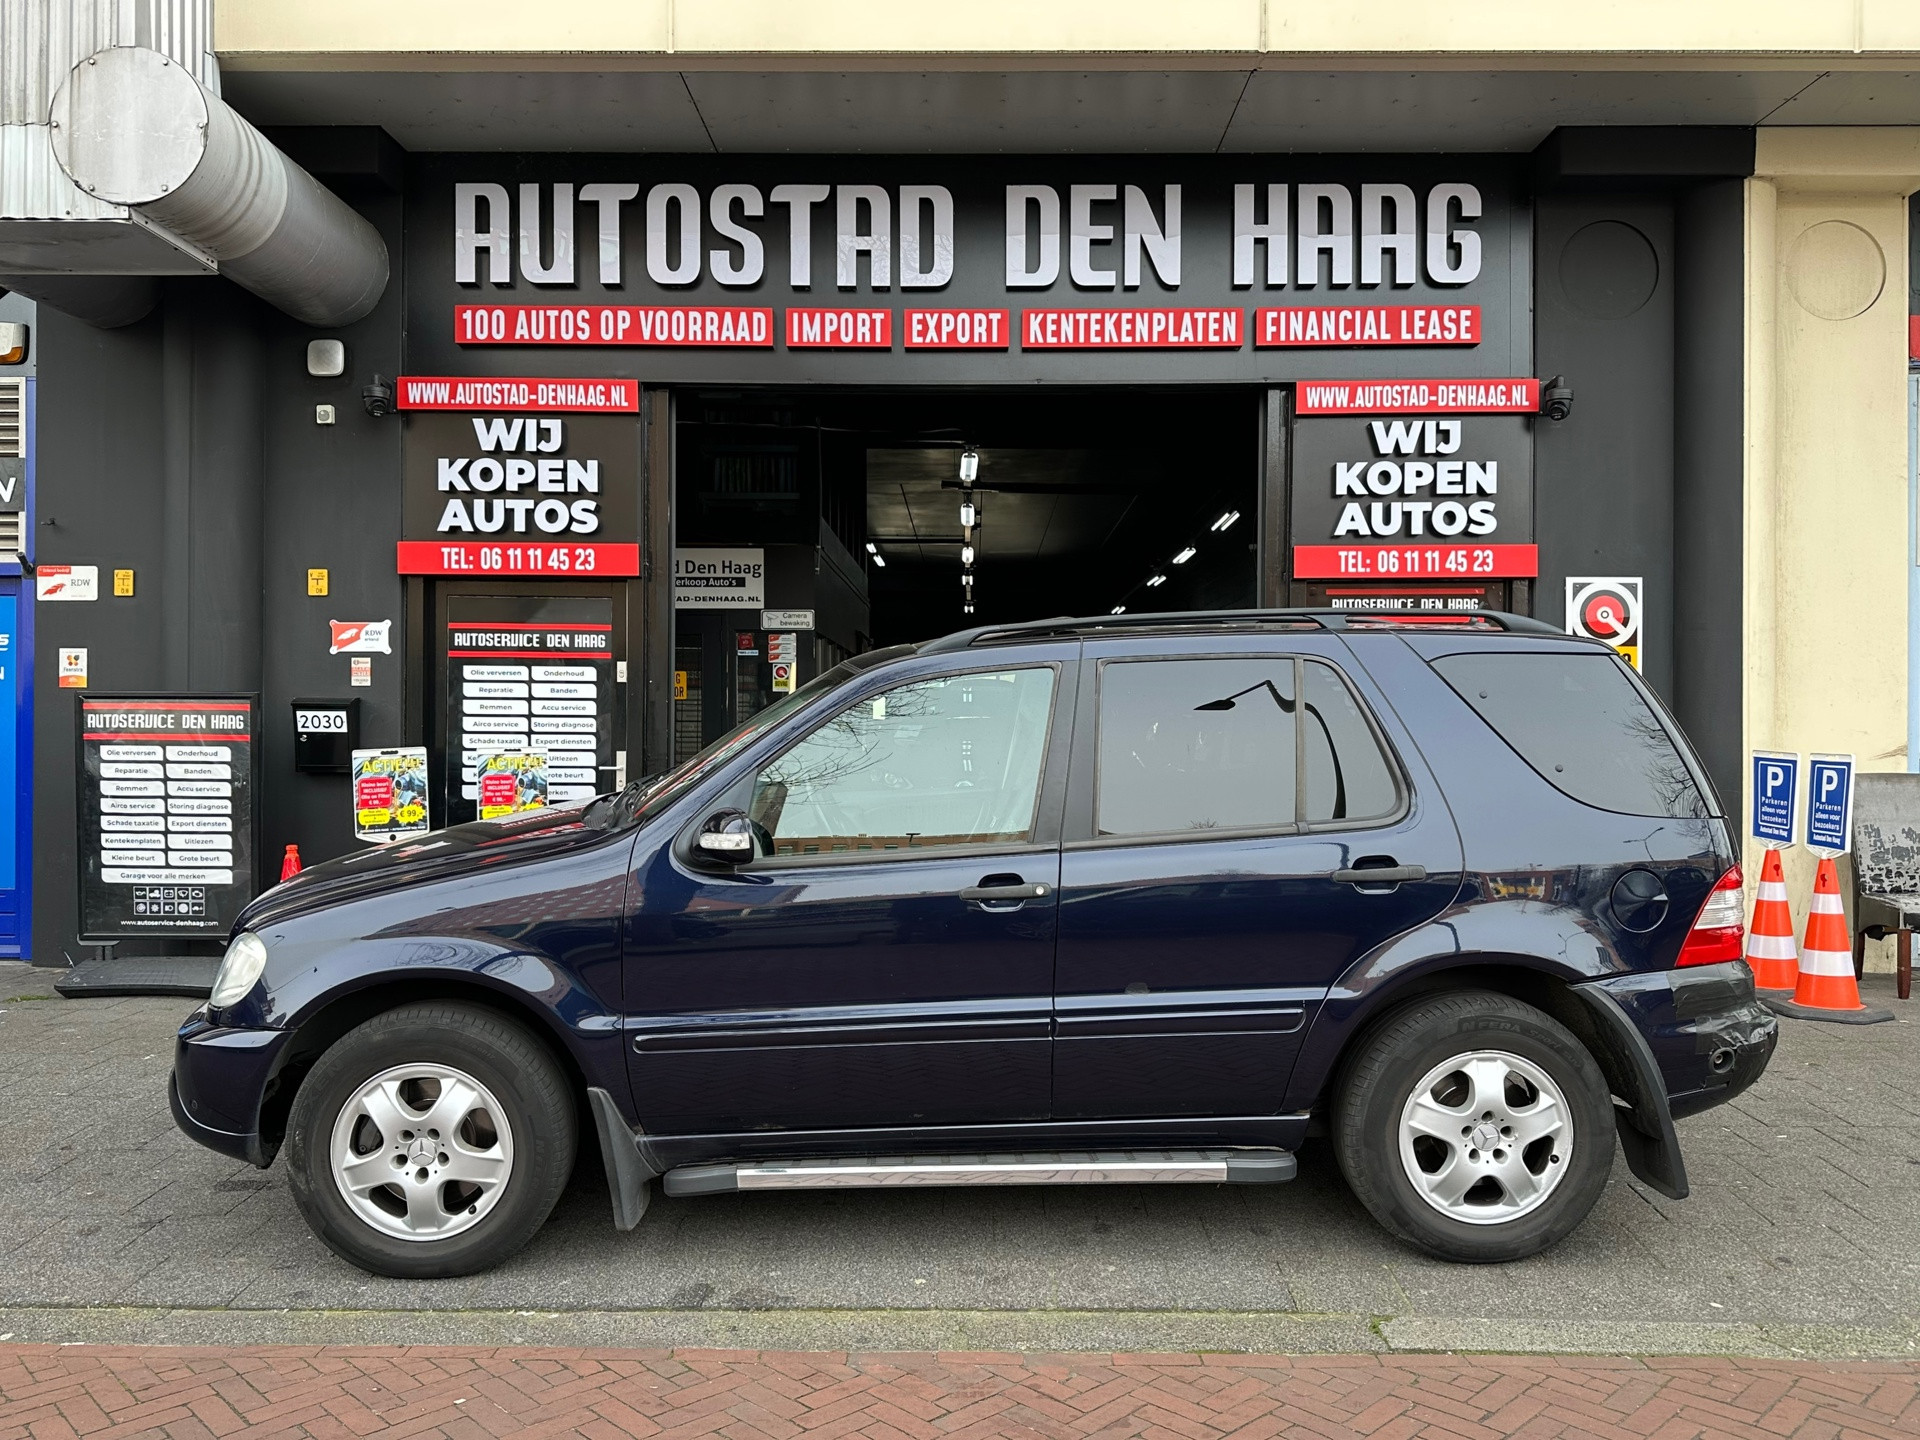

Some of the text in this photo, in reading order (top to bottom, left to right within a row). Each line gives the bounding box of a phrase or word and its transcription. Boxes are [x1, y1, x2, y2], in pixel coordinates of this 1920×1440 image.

[455, 183, 1482, 288] AUTOSTAD DEN HAAG
[462, 309, 766, 342] 100 AUTOS OP VOORRAAD
[792, 312, 884, 343] IMPORT
[912, 312, 1001, 343] EXPORT
[1029, 312, 1237, 343] KENTEKENPLATEN
[1266, 309, 1472, 342] FINANCIAL LEASE
[407, 382, 628, 407] WWW.AUTOSTAD-DENHAAG.NL
[1306, 384, 1529, 408] WWW.AUTOSTAD-DENHAAG.NL
[472, 418, 562, 452] WIJ
[1371, 420, 1461, 454] WIJ
[437, 457, 599, 493] KOPEN
[1335, 460, 1497, 495] KOPEN
[436, 499, 599, 534] AUTOS
[1333, 500, 1498, 536] AUTOS
[441, 547, 595, 571] TEL: 06 11 11 45 23
[1338, 549, 1494, 573] TEL: 06 11 11 45 23
[685, 560, 717, 574] Den
[722, 560, 762, 578] Haag
[70, 579, 90, 587] RDW
[675, 578, 737, 588] erkoop Auto's
[454, 633, 606, 648] AUTOSERVICE DEN HAAG
[478, 686, 514, 694] Reparatie
[87, 714, 244, 729] AUTOSERVICE DEN HAAG
[300, 715, 343, 729] 2030
[533, 721, 594, 729] Storing diagnose
[469, 737, 496, 745] Schade
[535, 738, 592, 746] Export diensten
[114, 767, 148, 775] Reparatie
[564, 771, 584, 779] beurt
[195, 785, 221, 793] service
[1767, 766, 1784, 797] P
[1821, 769, 1838, 802] P
[548, 788, 569, 796] erken
[110, 802, 128, 810] Airco
[169, 803, 228, 811] Storing diagnose
[1761, 797, 1788, 806] Parkeren
[1815, 802, 1841, 812] Parkeren
[171, 820, 227, 829] Export diensten
[1761, 814, 1787, 824] bezoekers
[1814, 821, 1840, 831] bezoekers
[120, 872, 146, 880] Garage
[164, 872, 177, 880] alle
[120, 920, 219, 928] www.autoservice-denhaag.com
